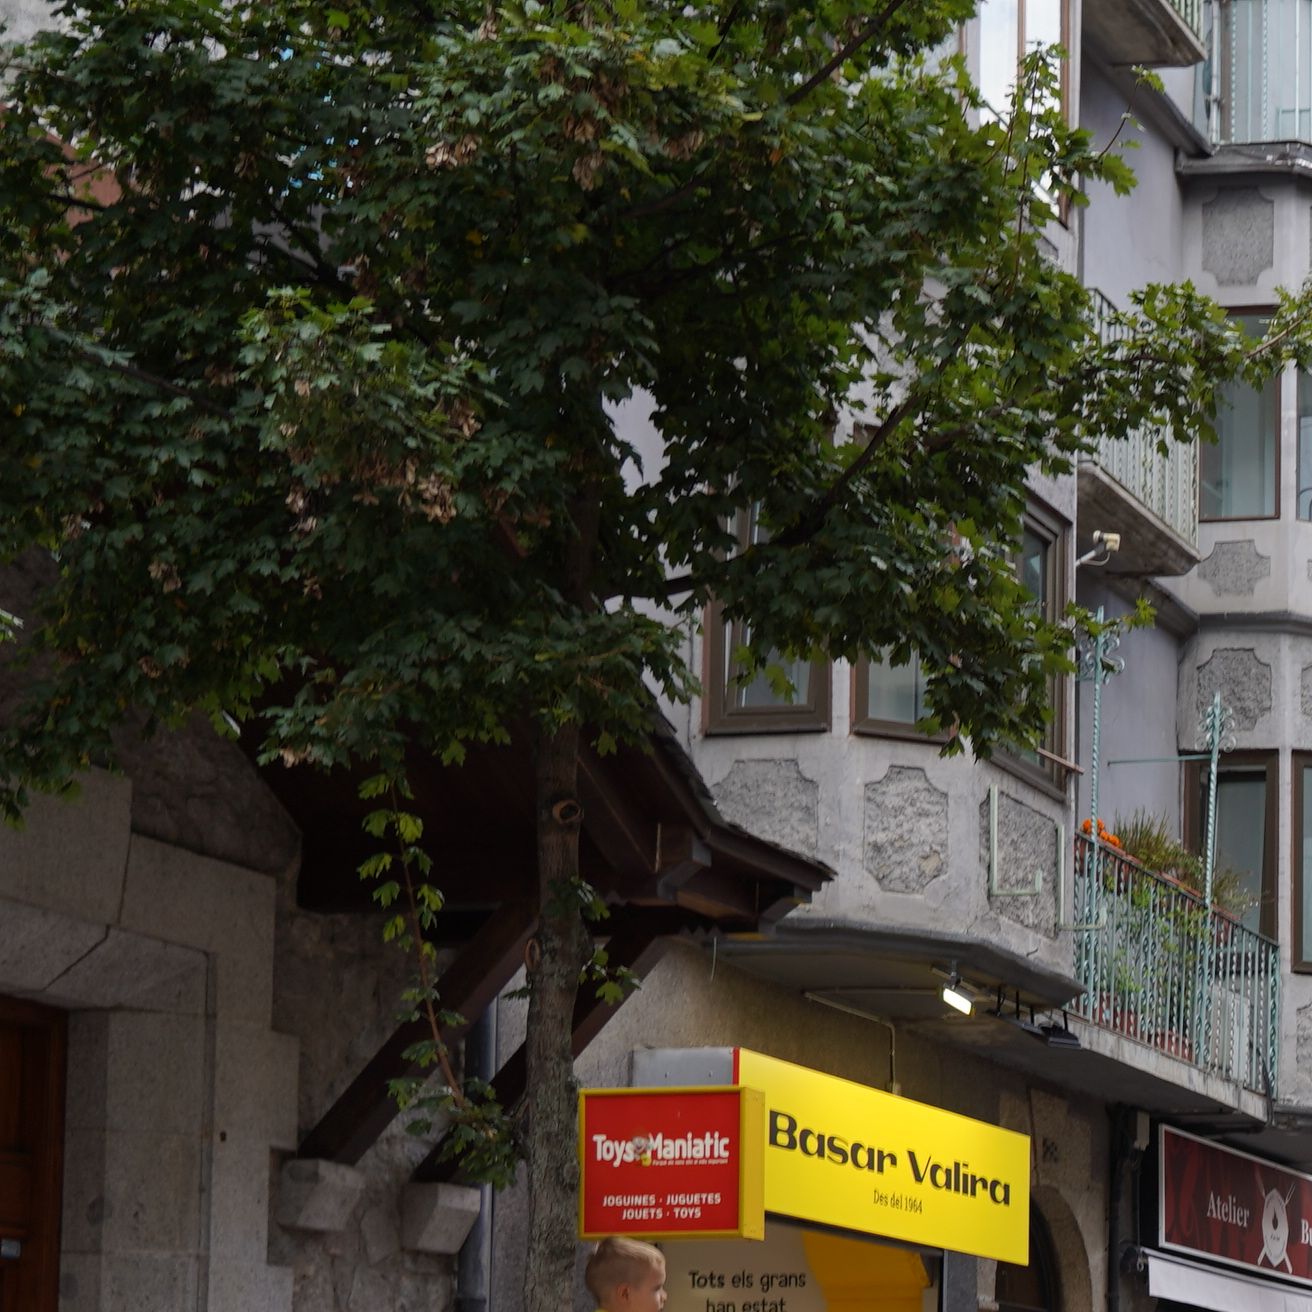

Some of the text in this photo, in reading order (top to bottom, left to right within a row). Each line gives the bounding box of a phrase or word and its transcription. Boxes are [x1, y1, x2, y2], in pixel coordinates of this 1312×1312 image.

[592, 1131, 730, 1168] Toys Maniatic
[768, 1109, 1011, 1207] Basar Valira
[602, 1192, 721, 1207] JOGUINES JUGUETES
[873, 1189, 924, 1215] Des del 1964
[1206, 1191, 1250, 1228] Atelier
[622, 1206, 701, 1220] JOUETS TOYS
[688, 1269, 807, 1293] Tots els grans
